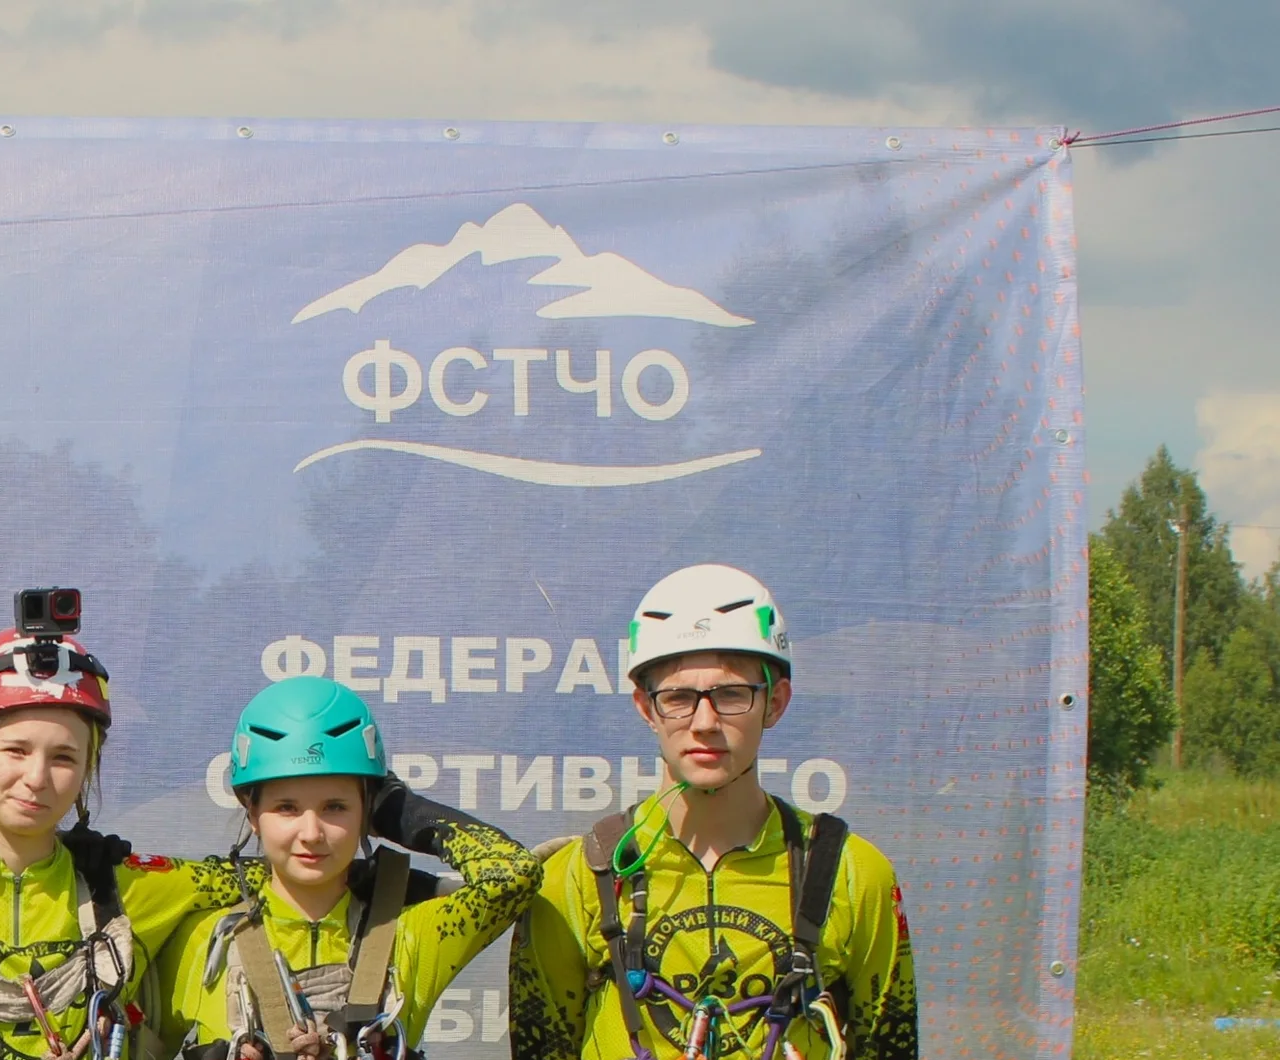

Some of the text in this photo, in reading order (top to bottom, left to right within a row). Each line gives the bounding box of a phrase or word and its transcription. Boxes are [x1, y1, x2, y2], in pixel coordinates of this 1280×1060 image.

[343, 339, 689, 423] ФСТЧО
[260, 634, 793, 703] ФЕДЕРА
[291, 756, 322, 765] VENTO
